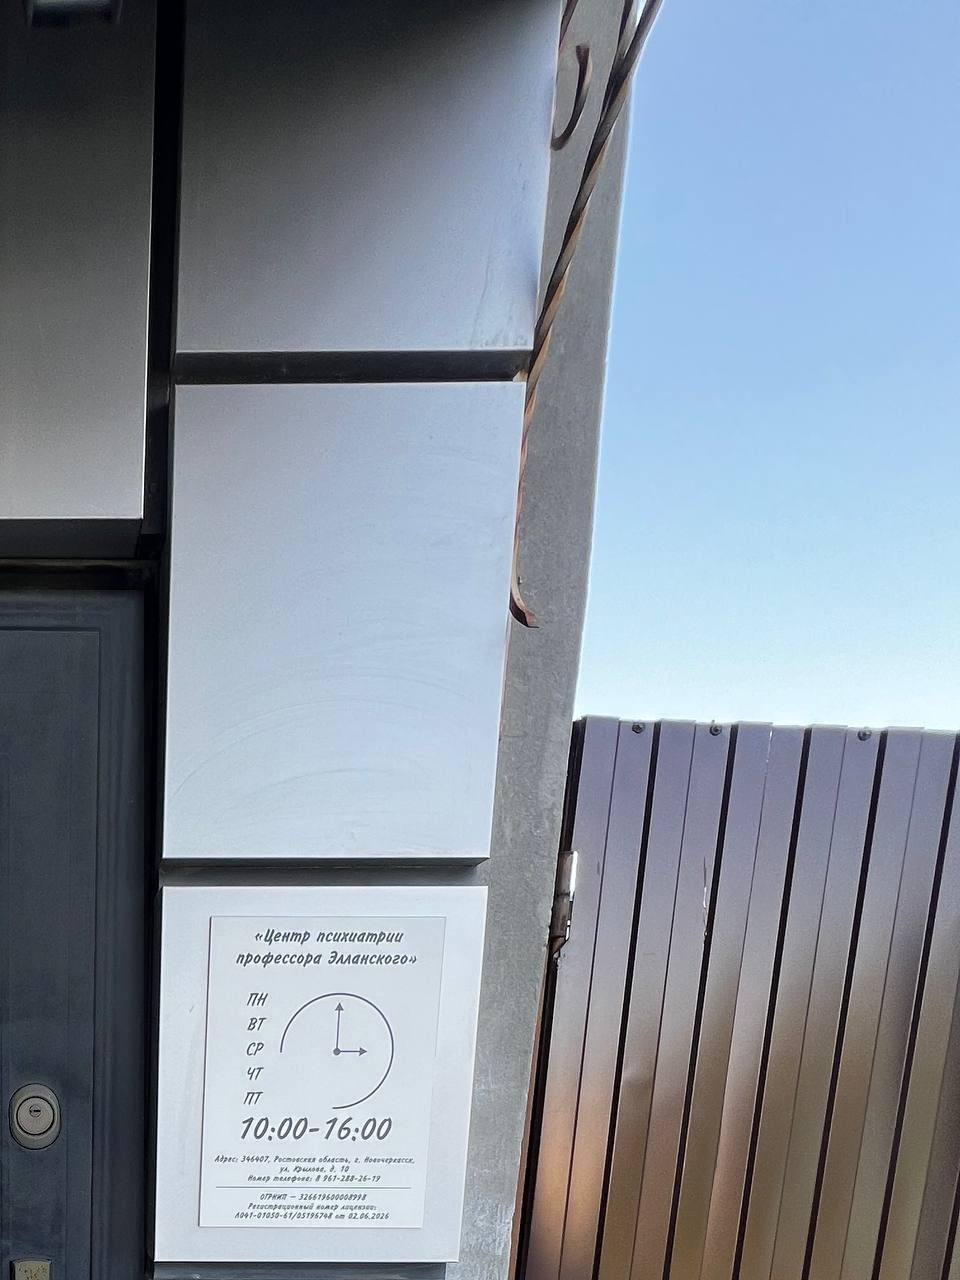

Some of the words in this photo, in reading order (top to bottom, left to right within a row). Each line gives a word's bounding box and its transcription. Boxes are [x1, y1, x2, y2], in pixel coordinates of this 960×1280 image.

[255, 929, 311, 945] «Центр
[316, 931, 404, 945] психиатрии
[236, 952, 322, 967] профессора
[328, 951, 417, 965] Элланского»
[247, 993, 268, 1006] ПН
[247, 1017, 267, 1031] ВТ
[247, 1042, 264, 1056] СР
[247, 1067, 264, 1080] ЧТ
[244, 1092, 263, 1105] ПТ
[241, 1117, 392, 1141] 10:00-16:00
[214, 1155, 238, 1164] Адрес:
[241, 1155, 271, 1164] 346407,
[273, 1155, 316, 1163] Ростовская
[319, 1155, 351, 1164] область,
[364, 1156, 415, 1164] Новочеркасск,
[279, 1166, 290, 1174] ул.
[329, 1165, 336, 1173] д.
[341, 1165, 350, 1173] 10
[247, 1174, 271, 1183] Номер
[260, 1193, 288, 1201] ОГРНИП
[247, 1202, 314, 1211] Регистрационный
